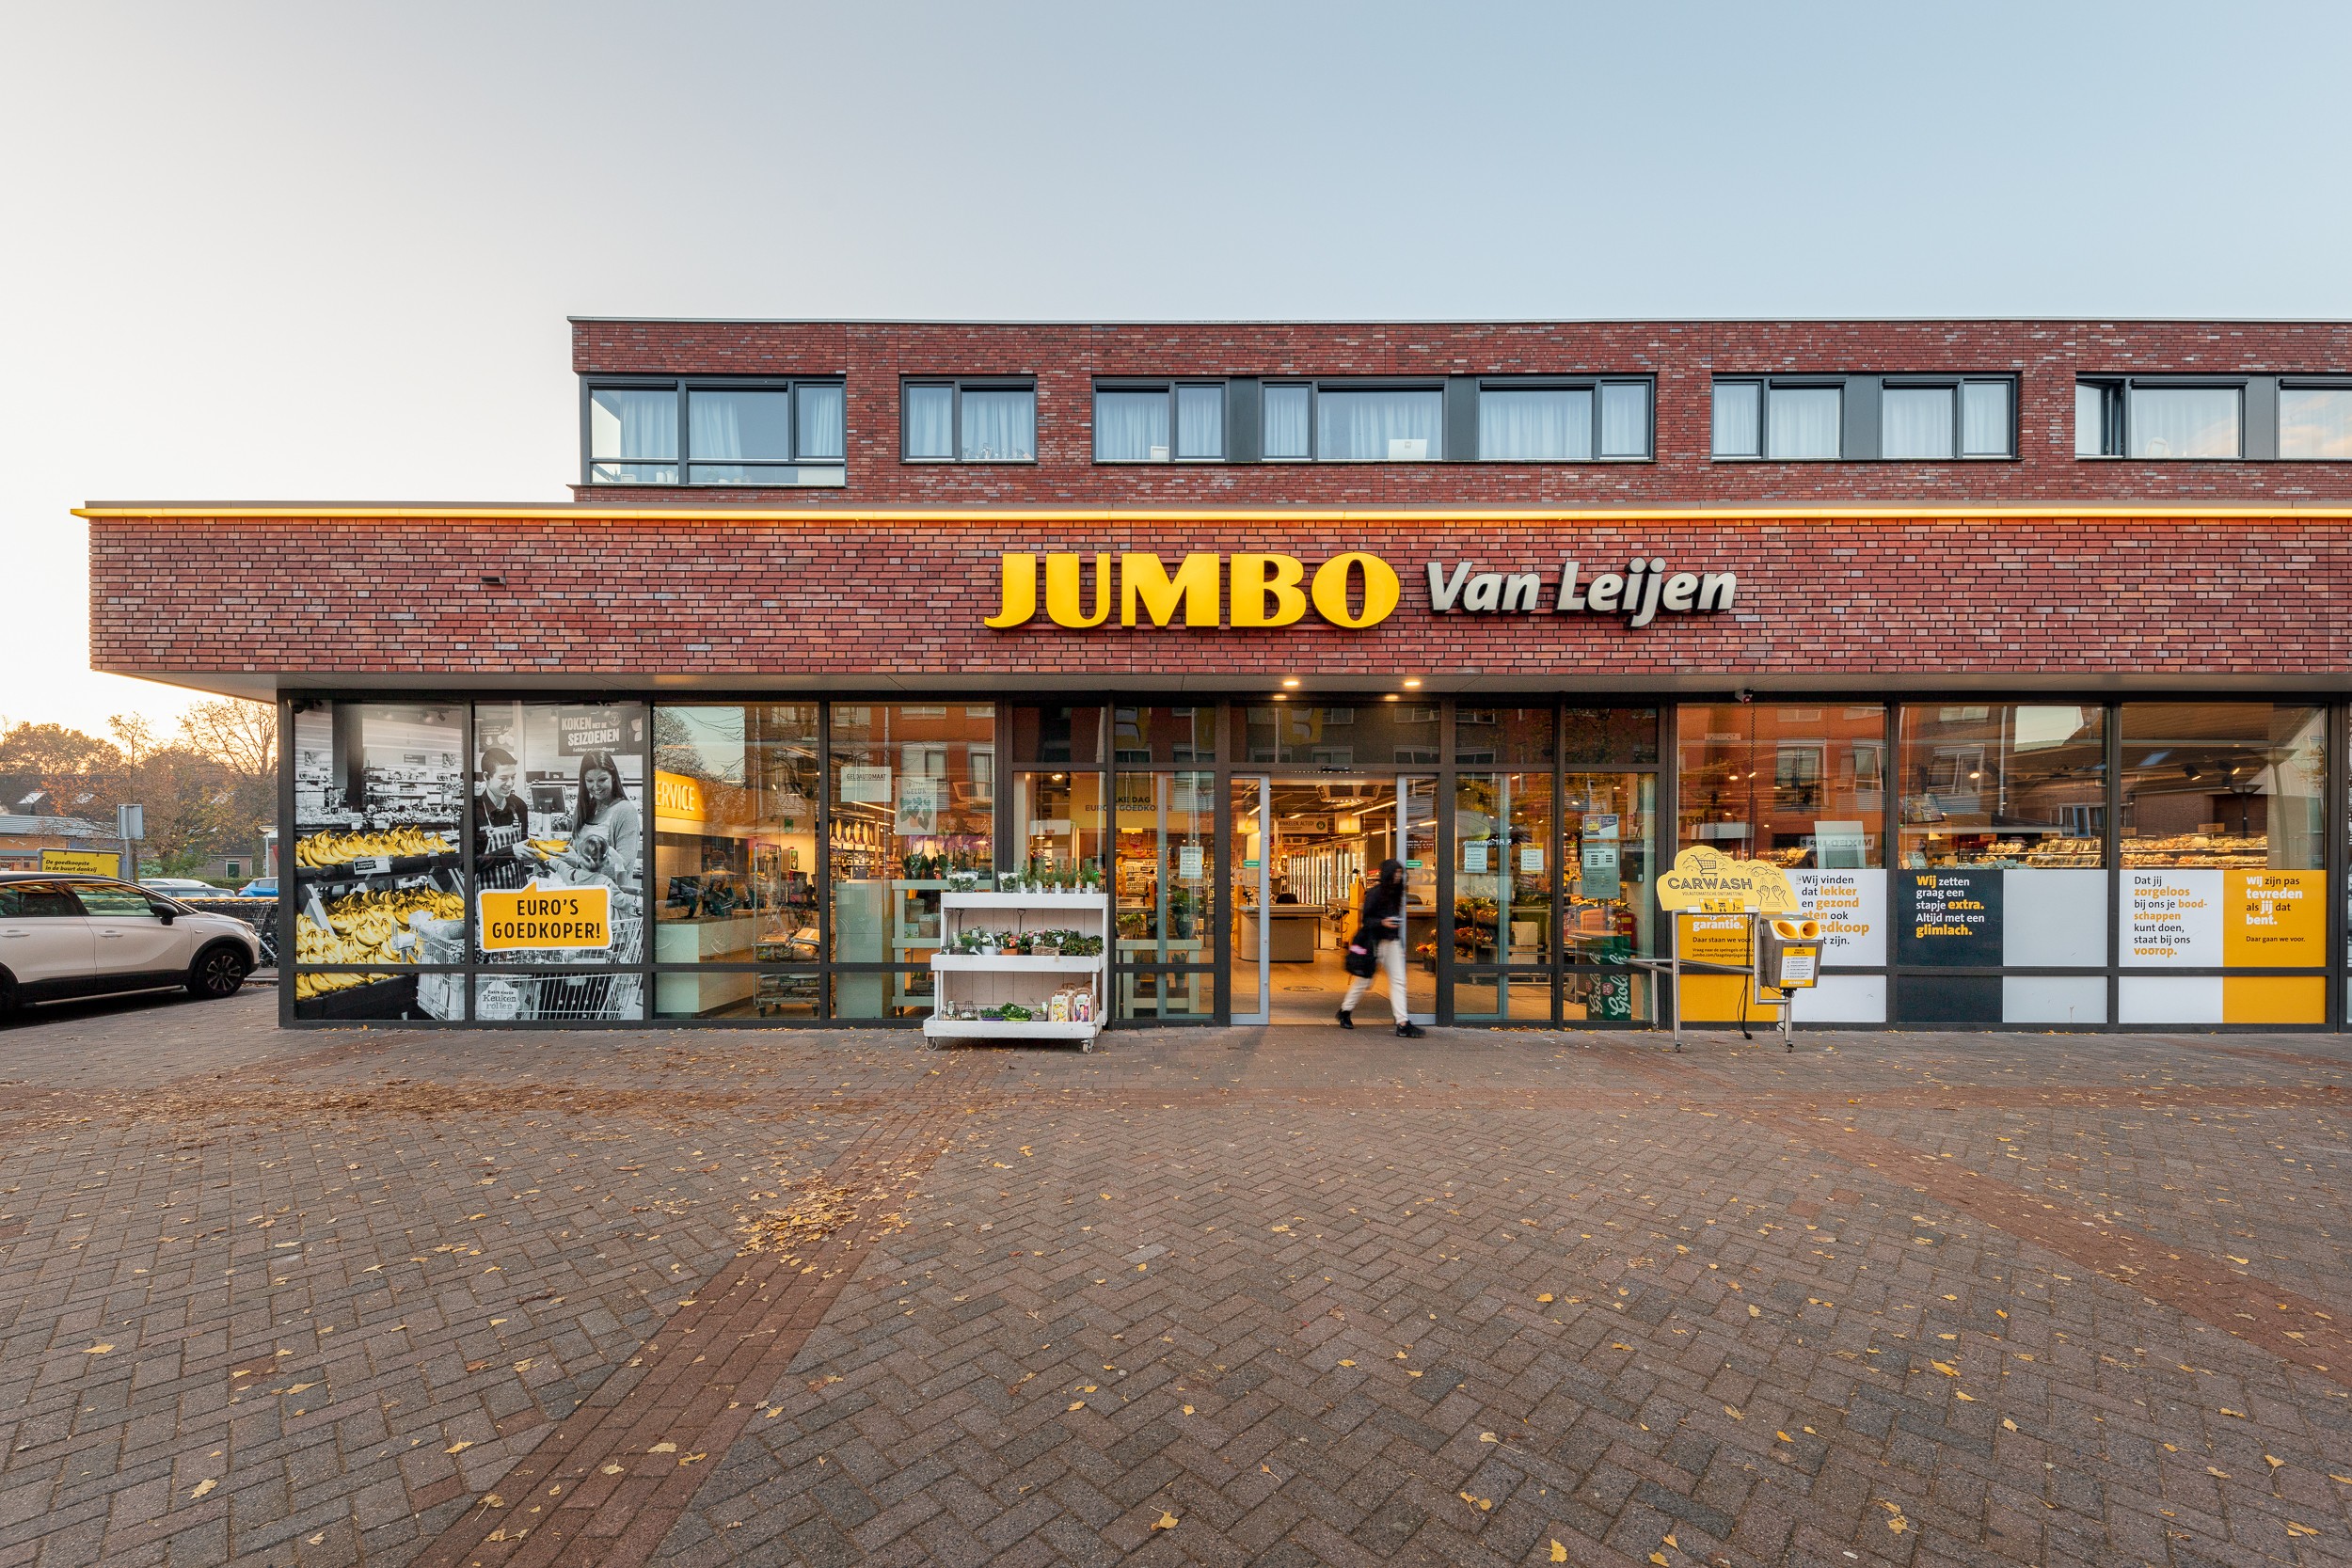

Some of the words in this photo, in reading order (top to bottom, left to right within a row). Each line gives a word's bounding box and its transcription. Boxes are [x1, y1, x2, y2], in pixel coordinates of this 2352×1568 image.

[984, 551, 1401, 628] JUMBO
[1425, 561, 1541, 611] Van
[1555, 557, 1737, 628] Leijen
[562, 717, 592, 730] KOKEN
[567, 728, 620, 746] SEIZOENEN
[655, 781, 695, 811] ERVICE
[1667, 877, 1753, 890] CARWASH
[1802, 875, 1818, 886] Wij
[1821, 875, 1854, 884] vinden
[1916, 875, 1936, 889] Wij
[1939, 878, 1970, 886] zetten
[2134, 876, 2151, 885] Dat
[2153, 876, 2162, 887] jij
[2246, 876, 2262, 887] Wij
[2265, 877, 2281, 887] zijn
[2284, 878, 2300, 887] pas
[1802, 887, 1818, 895] dat
[1820, 886, 1857, 895] lekker
[1916, 890, 1944, 899] graag
[2134, 886, 2190, 899] zorgeloos
[2246, 887, 2303, 899] tevreden
[517, 899, 579, 915] EURO'S
[1816, 897, 1859, 910] gezond
[1916, 900, 1946, 912] stapje
[1948, 899, 1984, 910] extra.
[2134, 900, 2146, 910] bij
[2166, 900, 2175, 910] je
[2178, 899, 2207, 908] bood-
[2260, 900, 2273, 914] jij
[1916, 913, 1942, 924] Altijd
[2134, 911, 2181, 922] schappen
[2246, 914, 2278, 925] bent.
[492, 922, 600, 939] GOEDKOPER!
[1692, 919, 1744, 932] garantie.
[1820, 921, 1870, 936] edkoop
[1916, 924, 1972, 938] glimlach.
[2158, 924, 2184, 933] doen,
[1830, 936, 1850, 947] zijn.
[2161, 935, 2171, 946] bij
[2134, 948, 2177, 958] voorop.
[1608, 952, 1631, 1016] Grolsh
